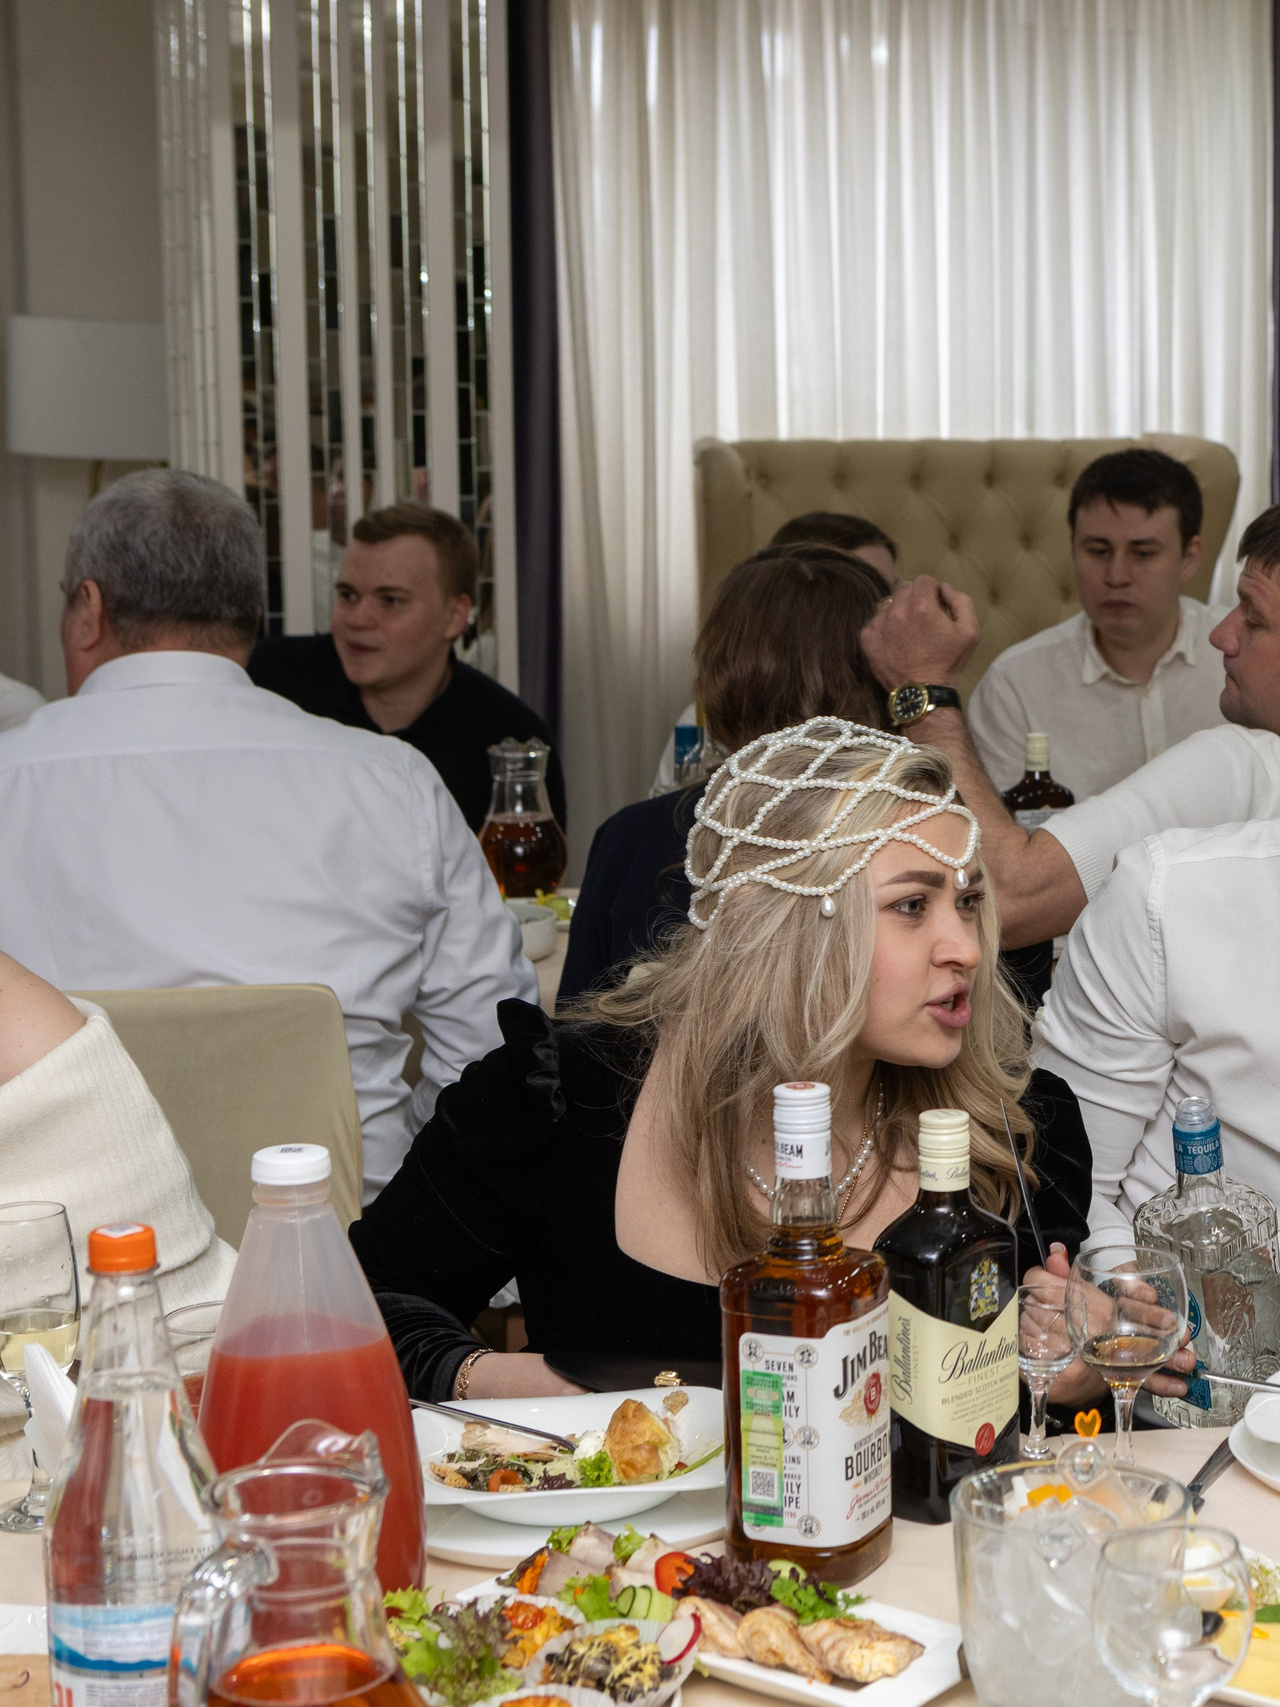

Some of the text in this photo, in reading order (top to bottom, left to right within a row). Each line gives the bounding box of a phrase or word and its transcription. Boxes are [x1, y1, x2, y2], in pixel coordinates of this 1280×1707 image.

[1187, 1140, 1220, 1155] TEQUILA
[764, 1359, 794, 1373] SEVEN
[833, 1330, 888, 1401] JIM BEA
[891, 1316, 913, 1406] Ballantine's
[938, 1333, 1018, 1385] Ballantine's
[968, 1366, 1000, 1386] FINEST
[941, 1388, 974, 1406] BLENDED
[784, 1404, 800, 1419] ILY
[845, 1432, 888, 1482] BOURBO
